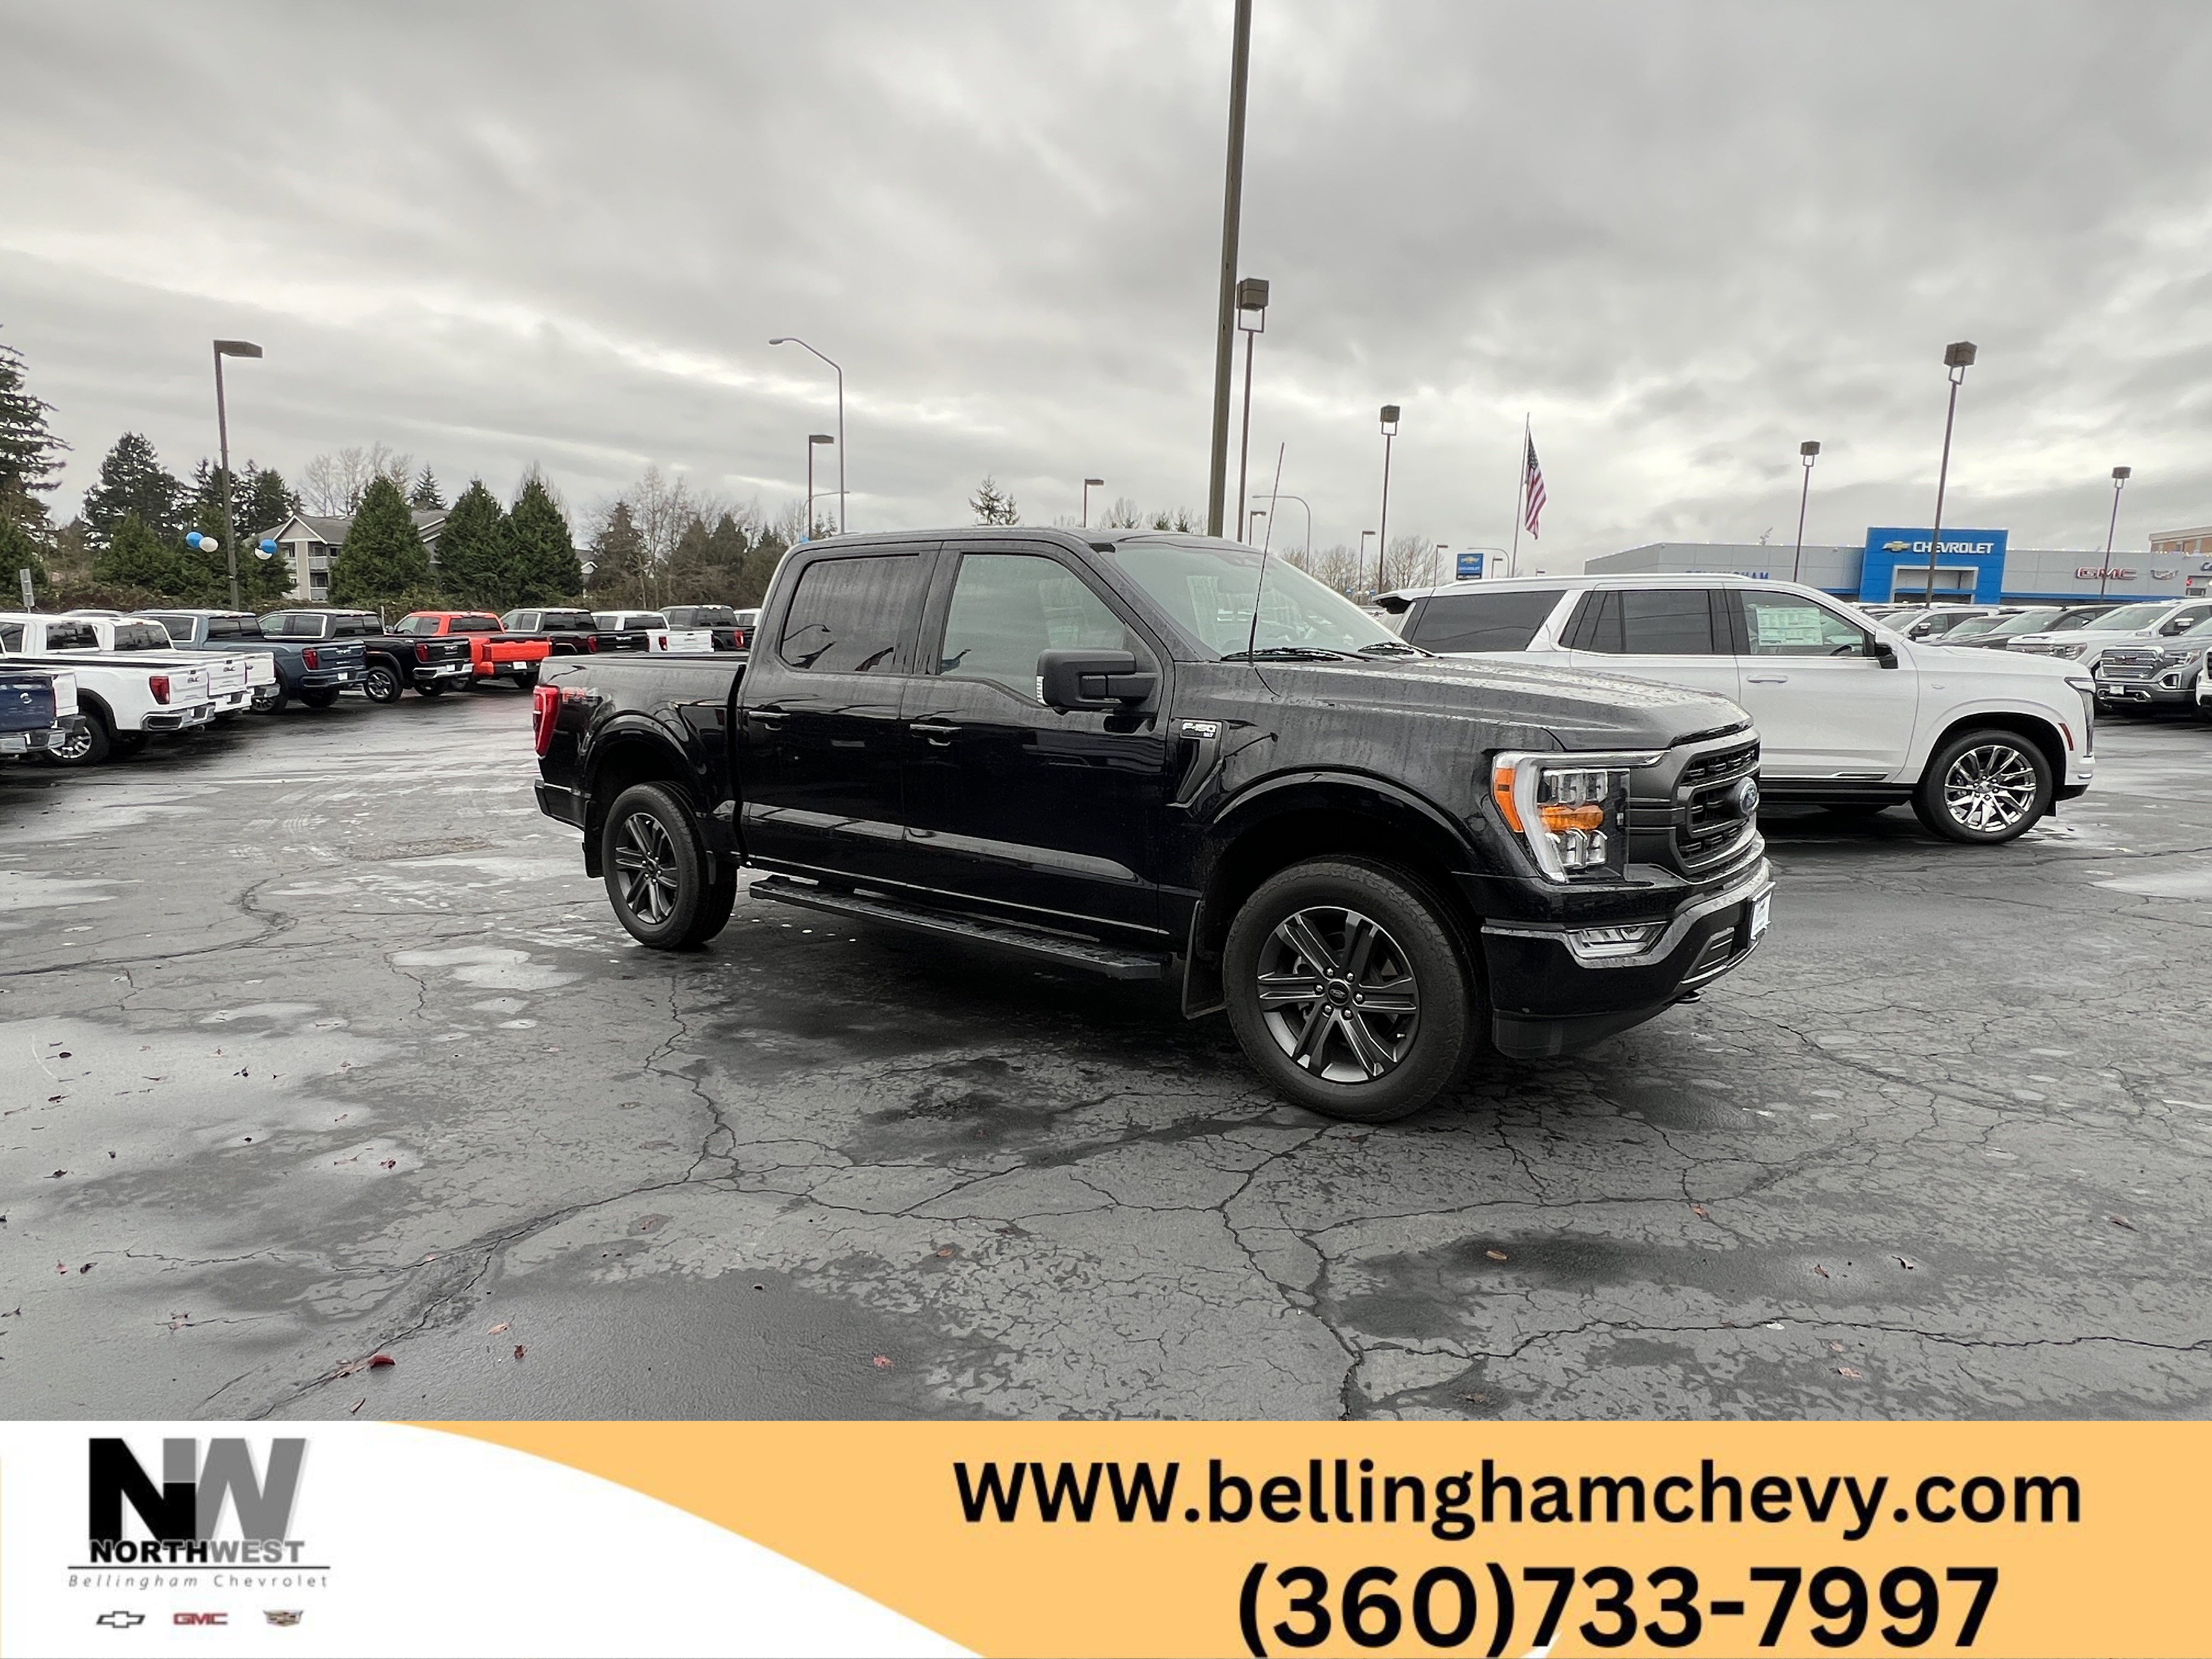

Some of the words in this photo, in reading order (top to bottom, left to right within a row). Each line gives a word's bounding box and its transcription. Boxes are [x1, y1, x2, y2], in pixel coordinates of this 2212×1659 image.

[1912, 541, 1994, 554] CHEVROLET
[2076, 567, 2137, 580] GMC
[562, 687, 599, 704] FX4
